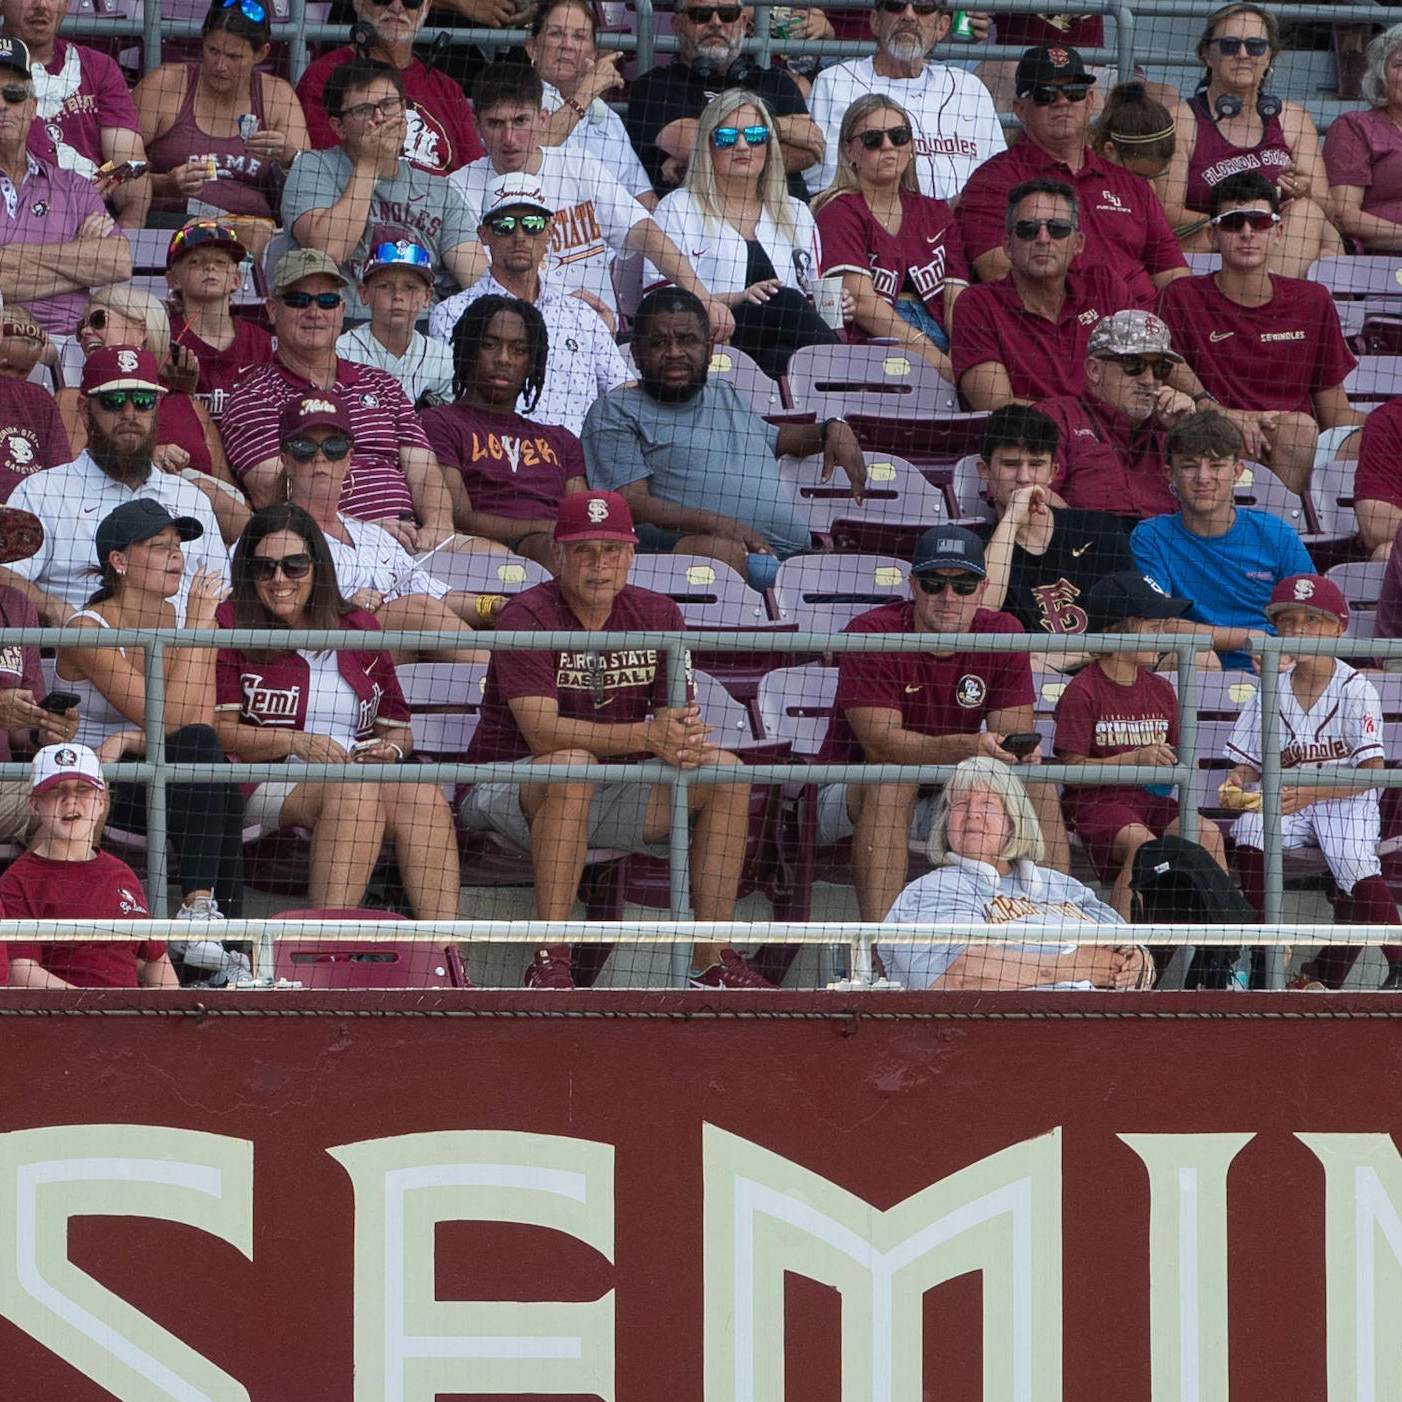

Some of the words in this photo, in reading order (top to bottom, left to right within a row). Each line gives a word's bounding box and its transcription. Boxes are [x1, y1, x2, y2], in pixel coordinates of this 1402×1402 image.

[914, 131, 978, 158] minoles
[1202, 155, 1261, 187] FLORIDA
[368, 200, 441, 237] NOLES
[551, 200, 601, 252] STATE
[1260, 331, 1305, 343] SEMINOLES
[471, 433, 561, 472] LOVER
[611, 649, 658, 668] STATE
[240, 673, 301, 719] Semi
